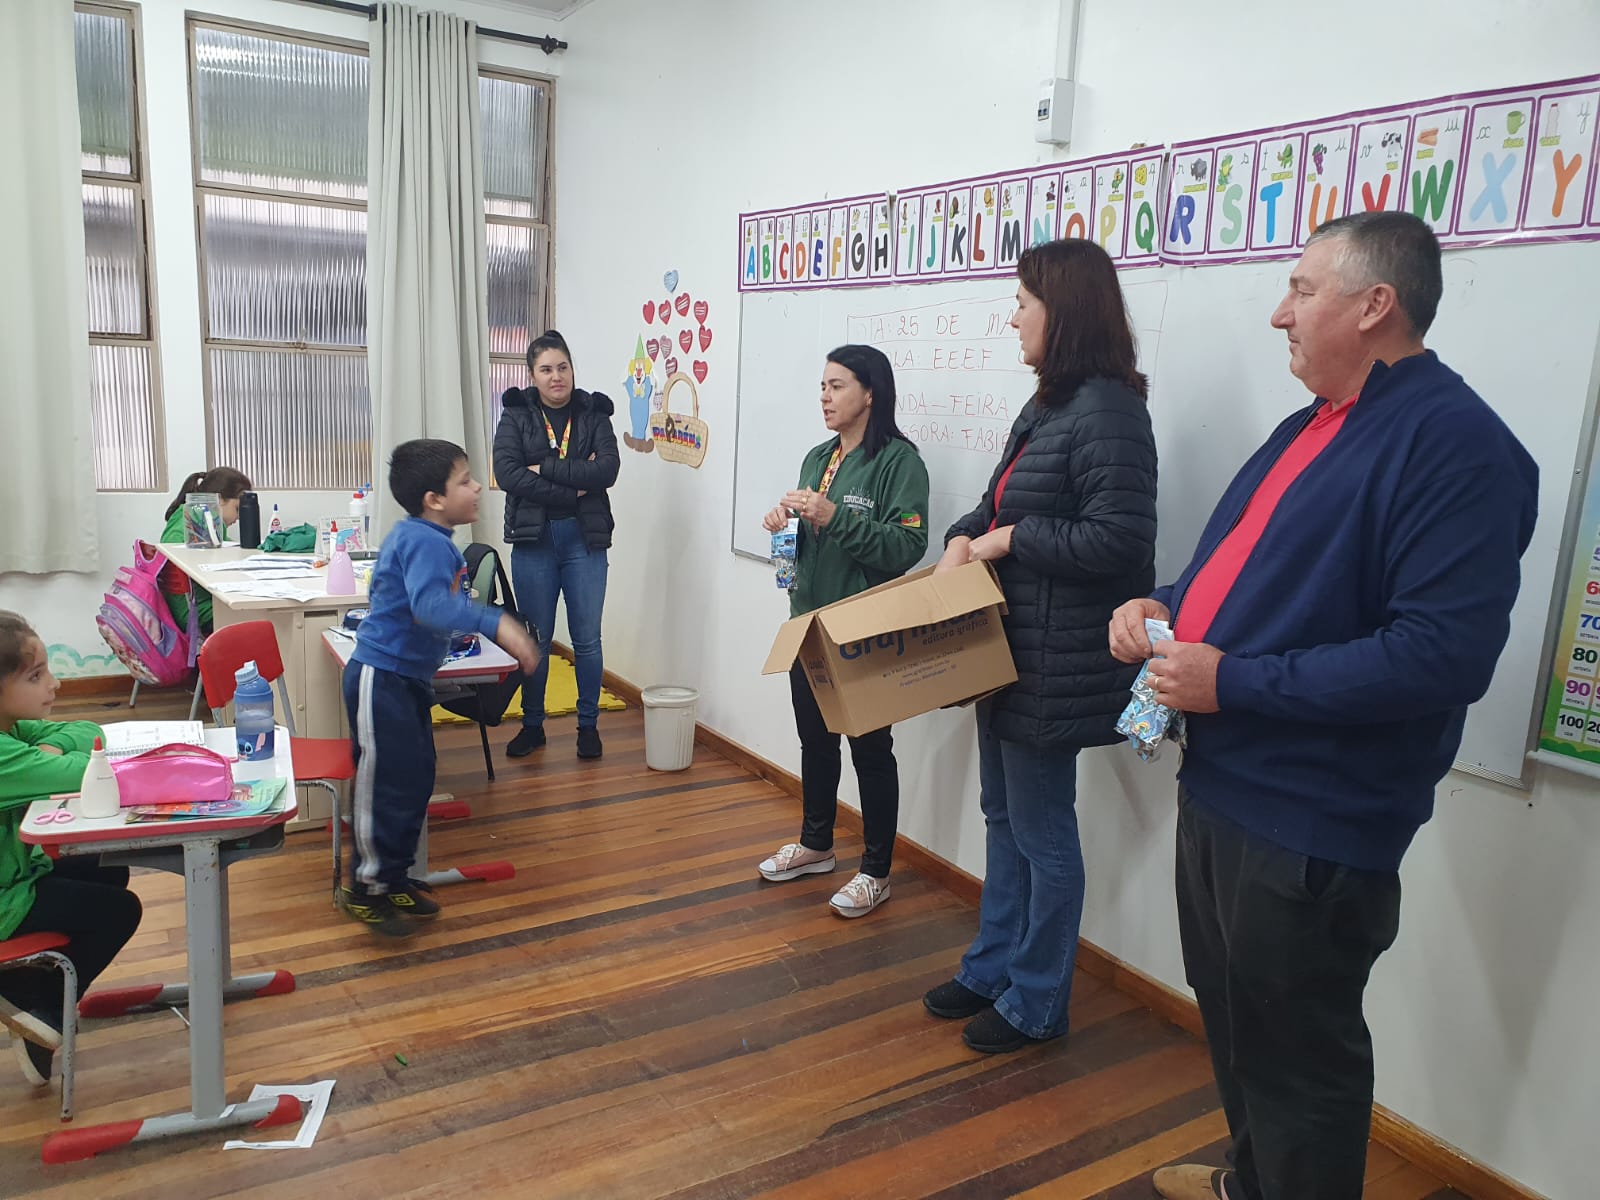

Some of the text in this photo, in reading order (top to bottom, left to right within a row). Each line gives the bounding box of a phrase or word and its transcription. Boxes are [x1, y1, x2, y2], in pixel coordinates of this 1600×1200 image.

[1169, 148, 1582, 246] R S T U V W X Y
[908, 224, 915, 270] I
[926, 224, 936, 268] J
[951, 223, 966, 266] K
[973, 212, 985, 262] L
[1000, 219, 1021, 263] M
[1033, 212, 1051, 249] N
[1100, 204, 1117, 249] P
[1134, 200, 1155, 254] Q
[746, 232, 888, 281] A B C D E F G H
[896, 315, 919, 337] 25
[935, 314, 961, 336] DE
[984, 308, 1017, 337] MA
[1585, 580, 1600, 596] 6
[922, 629, 954, 646] editora
[1572, 647, 1598, 664] 80
[1566, 679, 1591, 697] 90
[1559, 713, 1584, 729] 100
